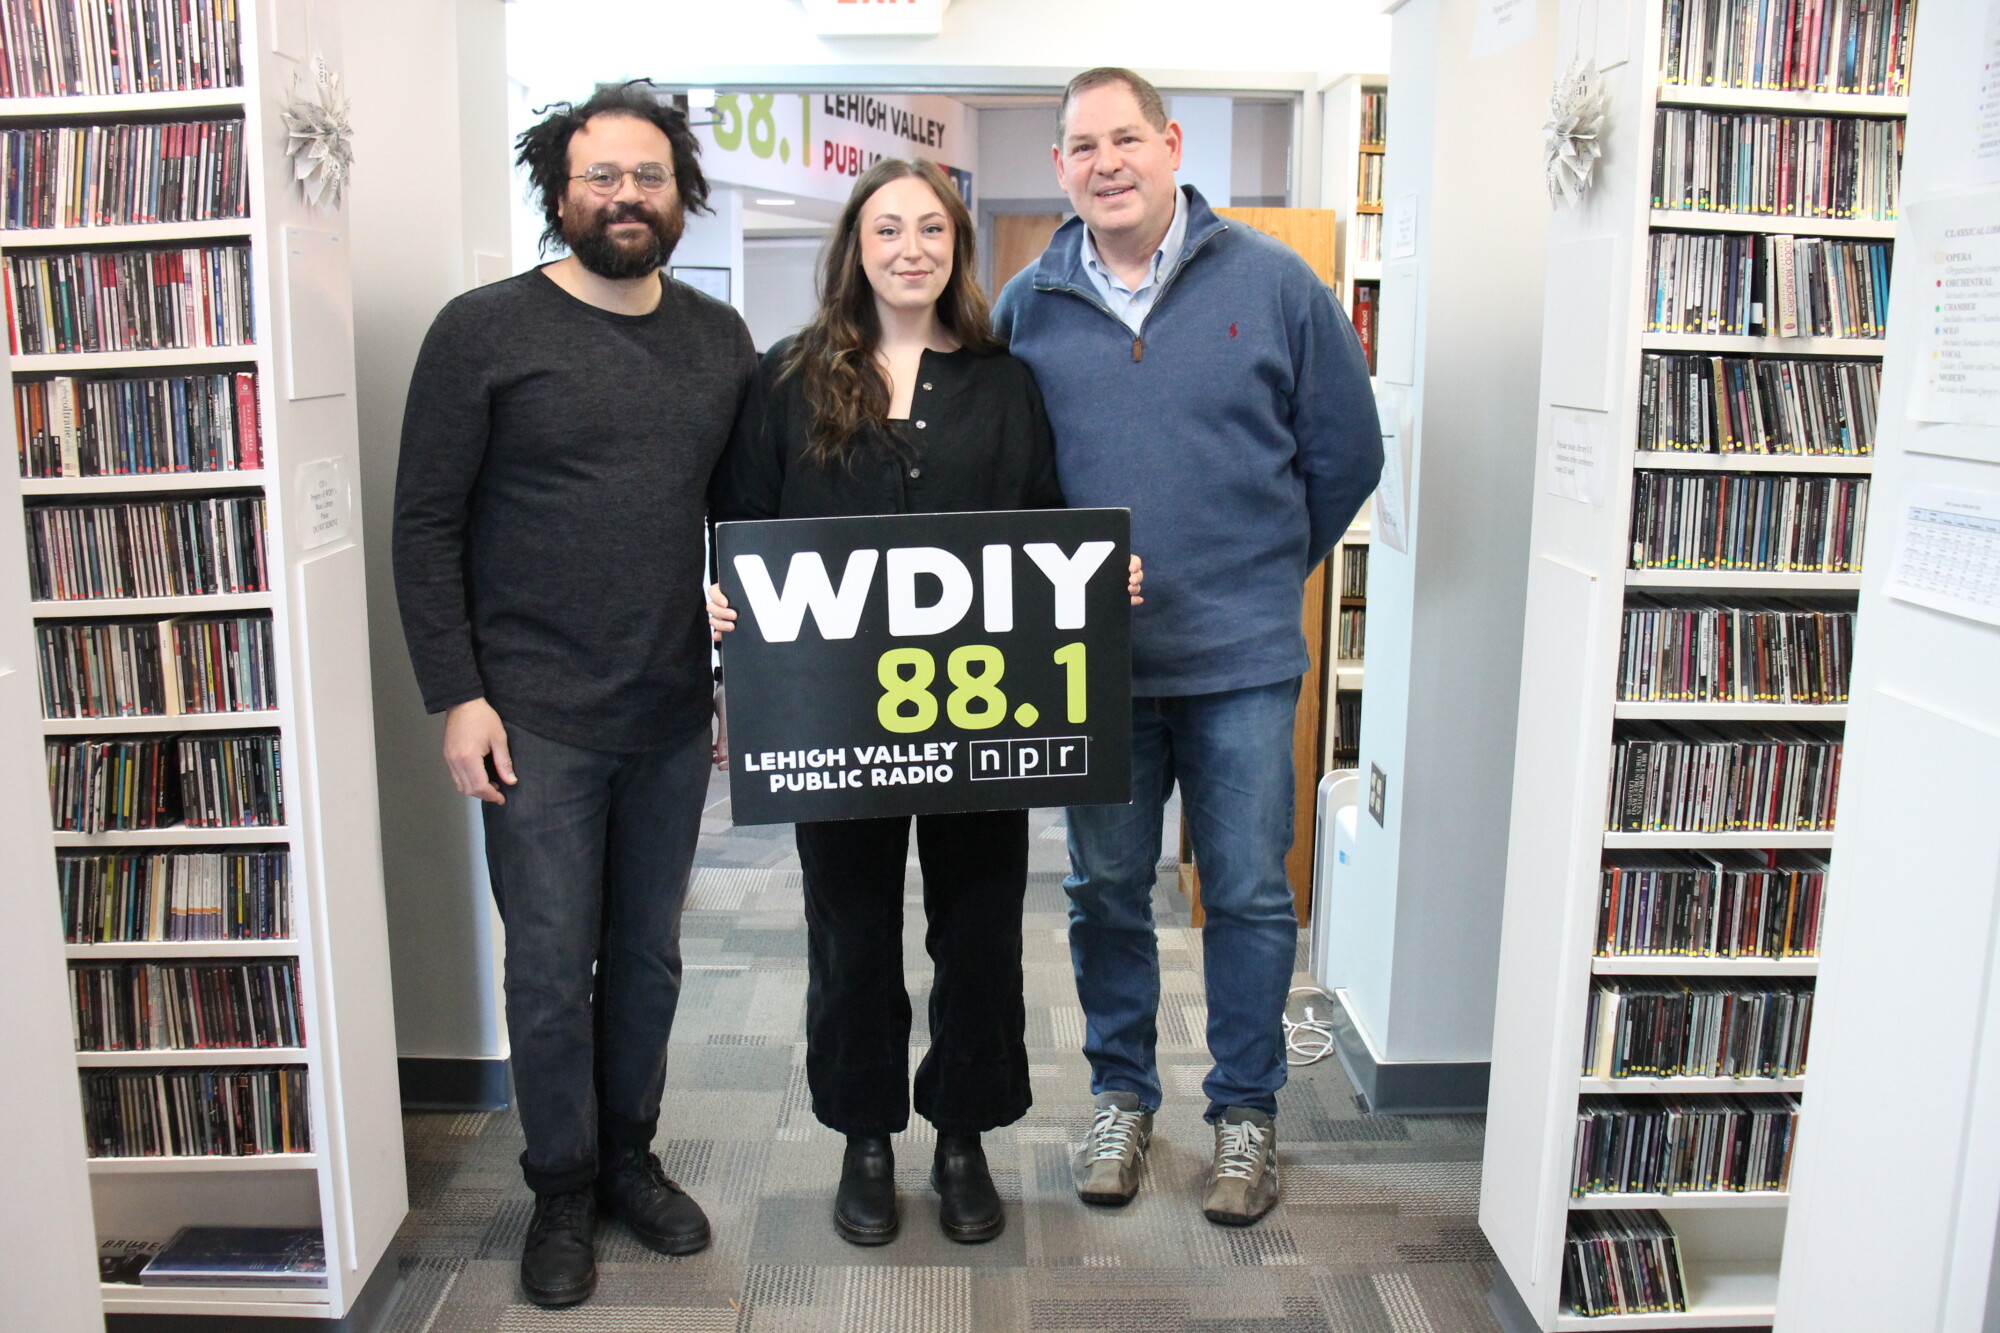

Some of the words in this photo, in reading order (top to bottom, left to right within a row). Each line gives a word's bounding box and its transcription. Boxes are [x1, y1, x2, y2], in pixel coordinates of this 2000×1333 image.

[824, 95, 887, 132] LEHIGH
[891, 107, 945, 149] VALLEY
[1784, 241, 1793, 265] TODD
[1946, 253, 1972, 262] OPERA
[1785, 269, 1795, 317] RUNDGREN
[1945, 277, 1992, 288] ORCHESTRAL
[62, 396, 73, 438] coltrane
[733, 540, 1116, 643] WDIY
[876, 641, 1087, 734] 88.1
[745, 745, 847, 772] LEHIGH
[853, 741, 958, 766] VALLEY
[981, 742, 1075, 777] npr
[770, 771, 864, 793] PUBLIC
[871, 764, 953, 786] RADIO
